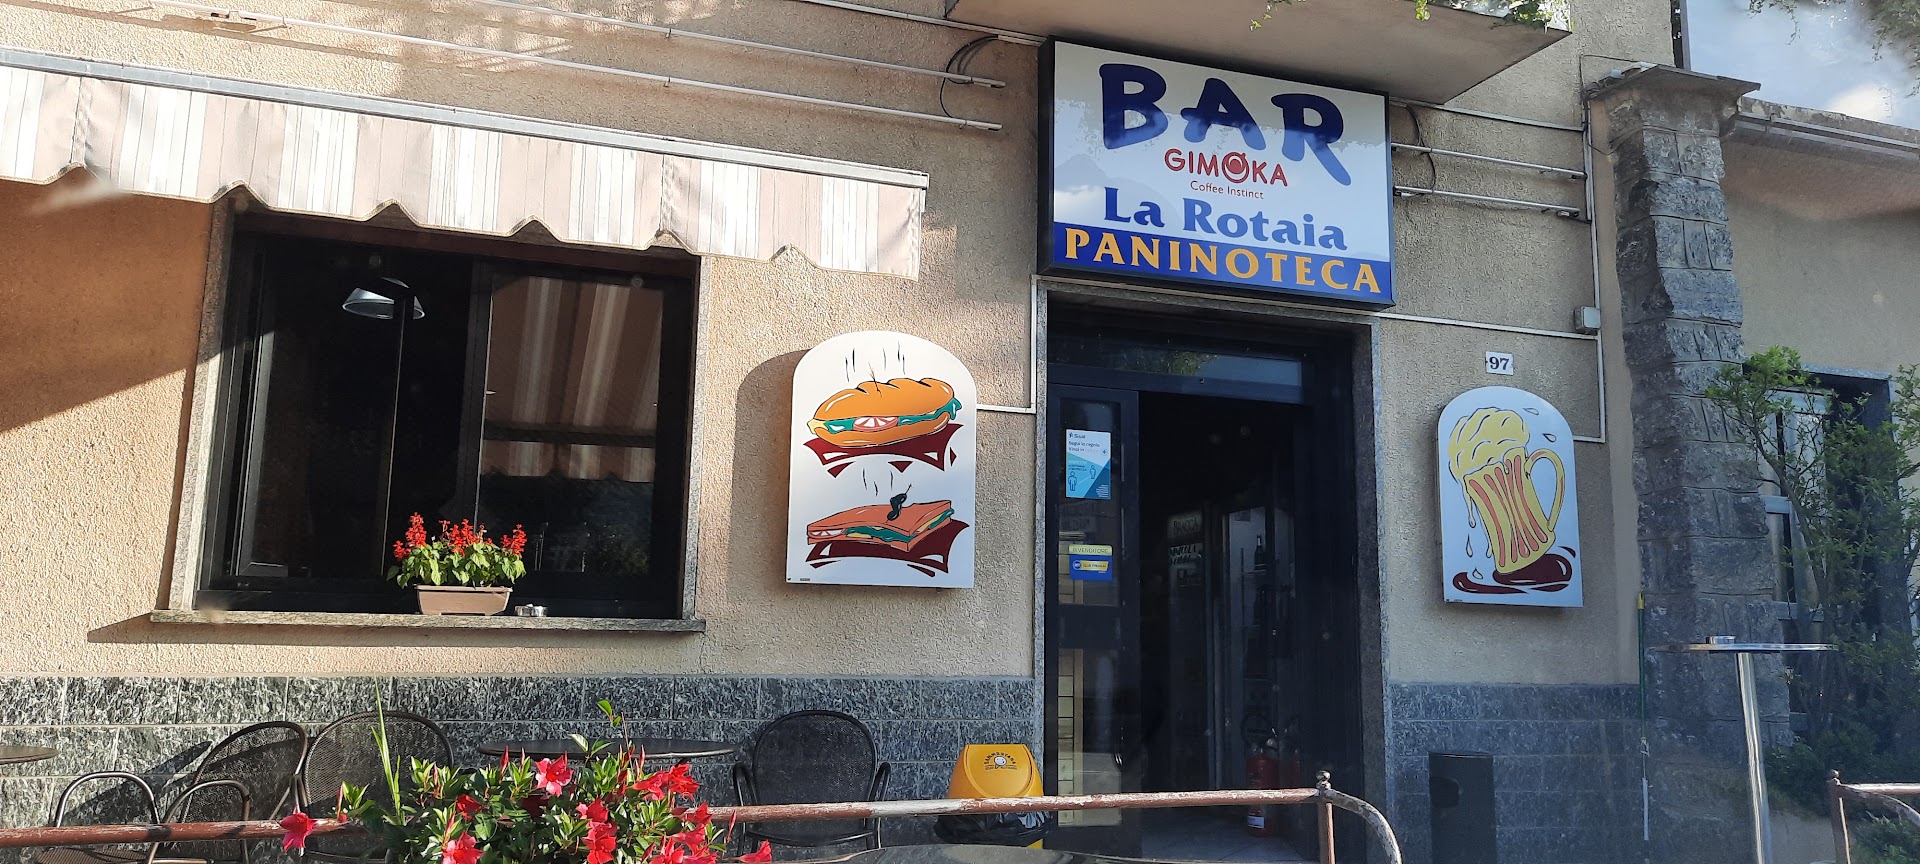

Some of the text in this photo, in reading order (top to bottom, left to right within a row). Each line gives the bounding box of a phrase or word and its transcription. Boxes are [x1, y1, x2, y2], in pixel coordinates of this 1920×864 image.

[1099, 63, 1351, 186] BAR
[1164, 148, 1288, 187] GIMOKA
[1190, 180, 1265, 200] Coffee Instinct
[1104, 186, 1348, 250] La Rotaia
[1065, 227, 1382, 293] PANINOTECA
[1489, 356, 1510, 370] 97
